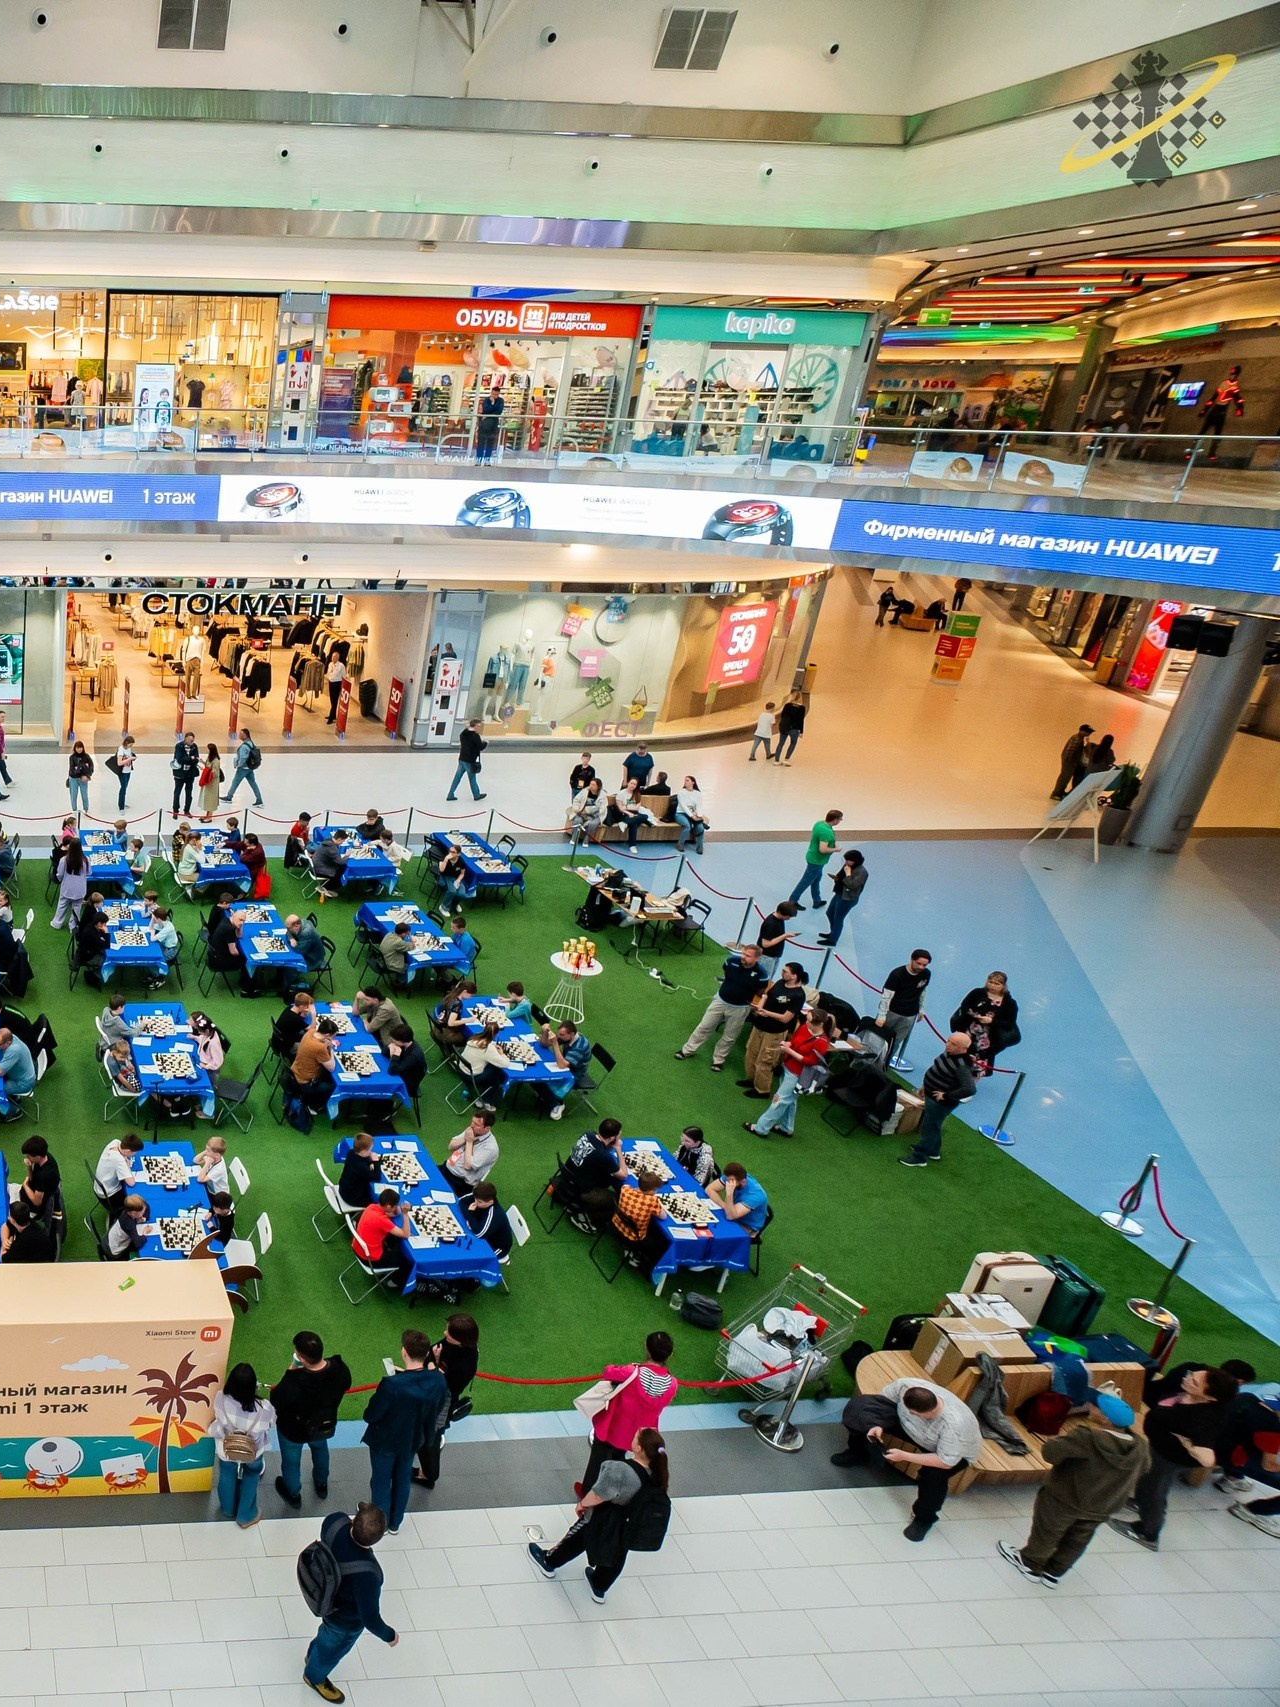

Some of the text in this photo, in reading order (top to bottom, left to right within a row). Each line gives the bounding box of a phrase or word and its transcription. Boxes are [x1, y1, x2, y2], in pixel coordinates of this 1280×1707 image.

[456, 308, 518, 328] ОБУВЬ
[549, 312, 591, 322] ДЛЯ ДЕТЕЙ
[548, 321, 606, 331] И ПОДРОСТКОВ
[725, 311, 795, 340] kapika
[49, 490, 113, 504] HUAWEI
[143, 489, 150, 503] 1
[154, 490, 196, 504] этаж
[863, 519, 994, 546] Фирменный
[999, 533, 1099, 555] магазин
[1104, 539, 1219, 566] HUAWEI
[142, 591, 343, 616] СТОКМАНН
[44, 1384, 128, 1397] магазин
[23, 1402, 32, 1414] 1
[39, 1403, 89, 1414] этаж
